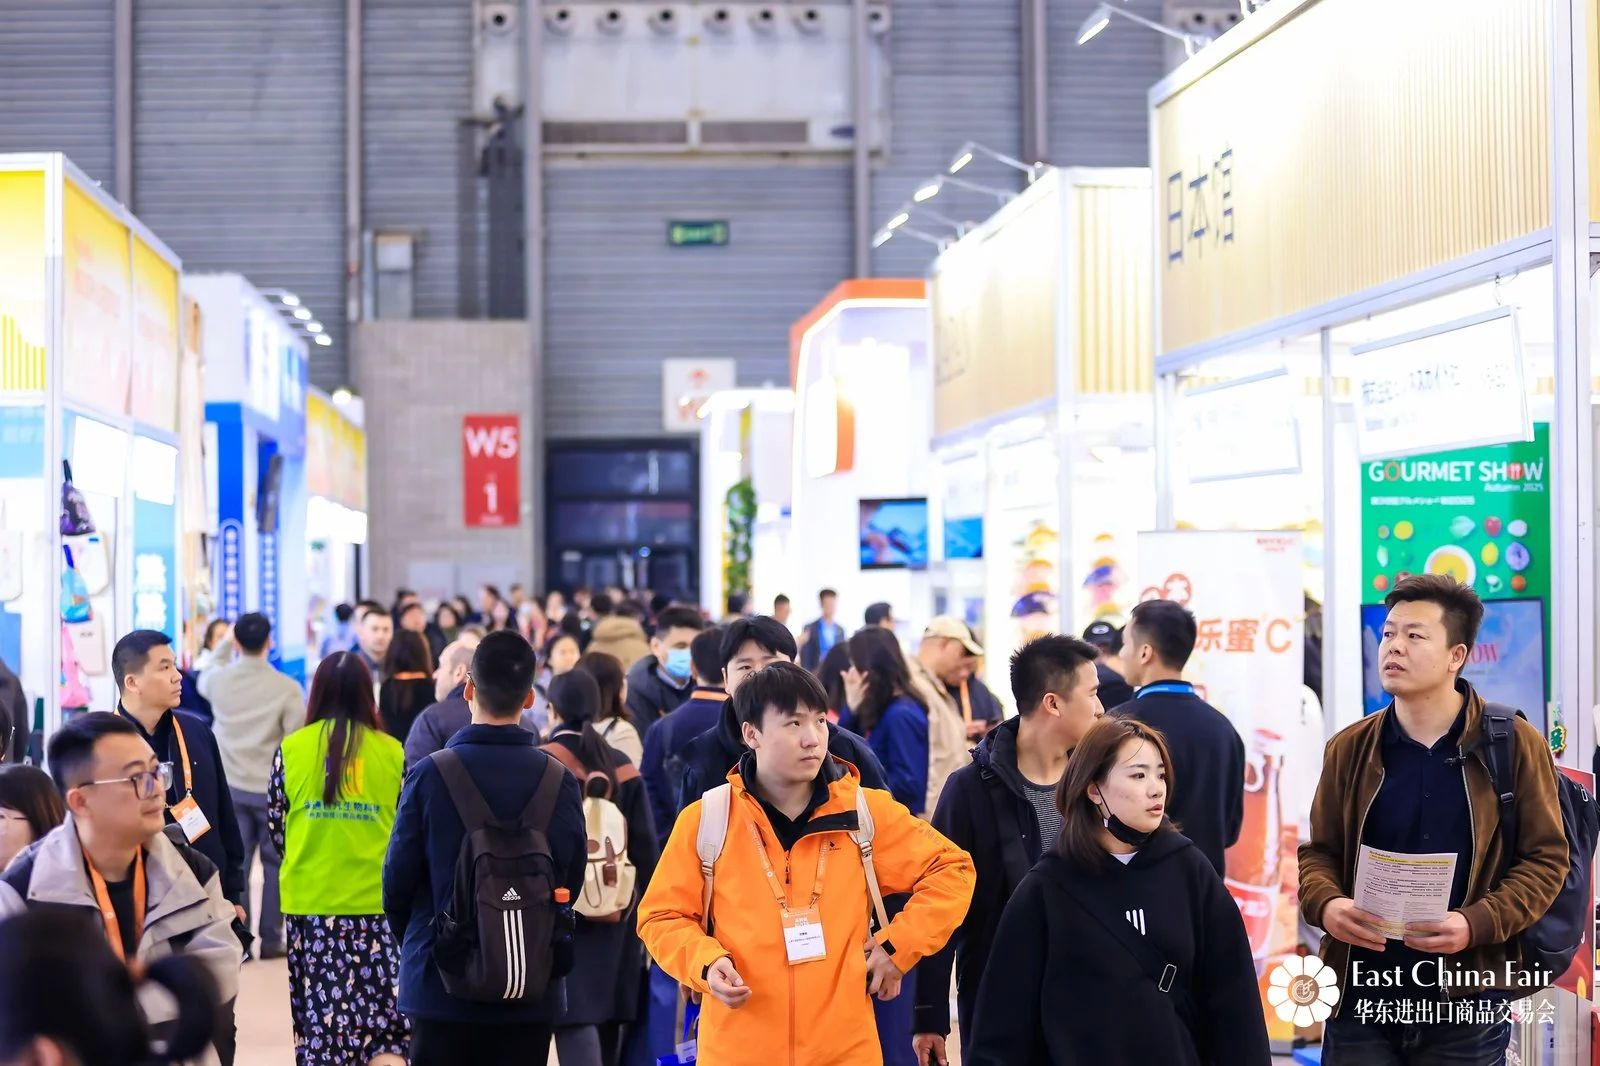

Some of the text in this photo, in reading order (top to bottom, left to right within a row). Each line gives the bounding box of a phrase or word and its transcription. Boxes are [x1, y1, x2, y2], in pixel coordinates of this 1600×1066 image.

[464, 426, 518, 459] W5
[1368, 461, 1474, 482] GOURMET
[483, 482, 498, 514] 1
